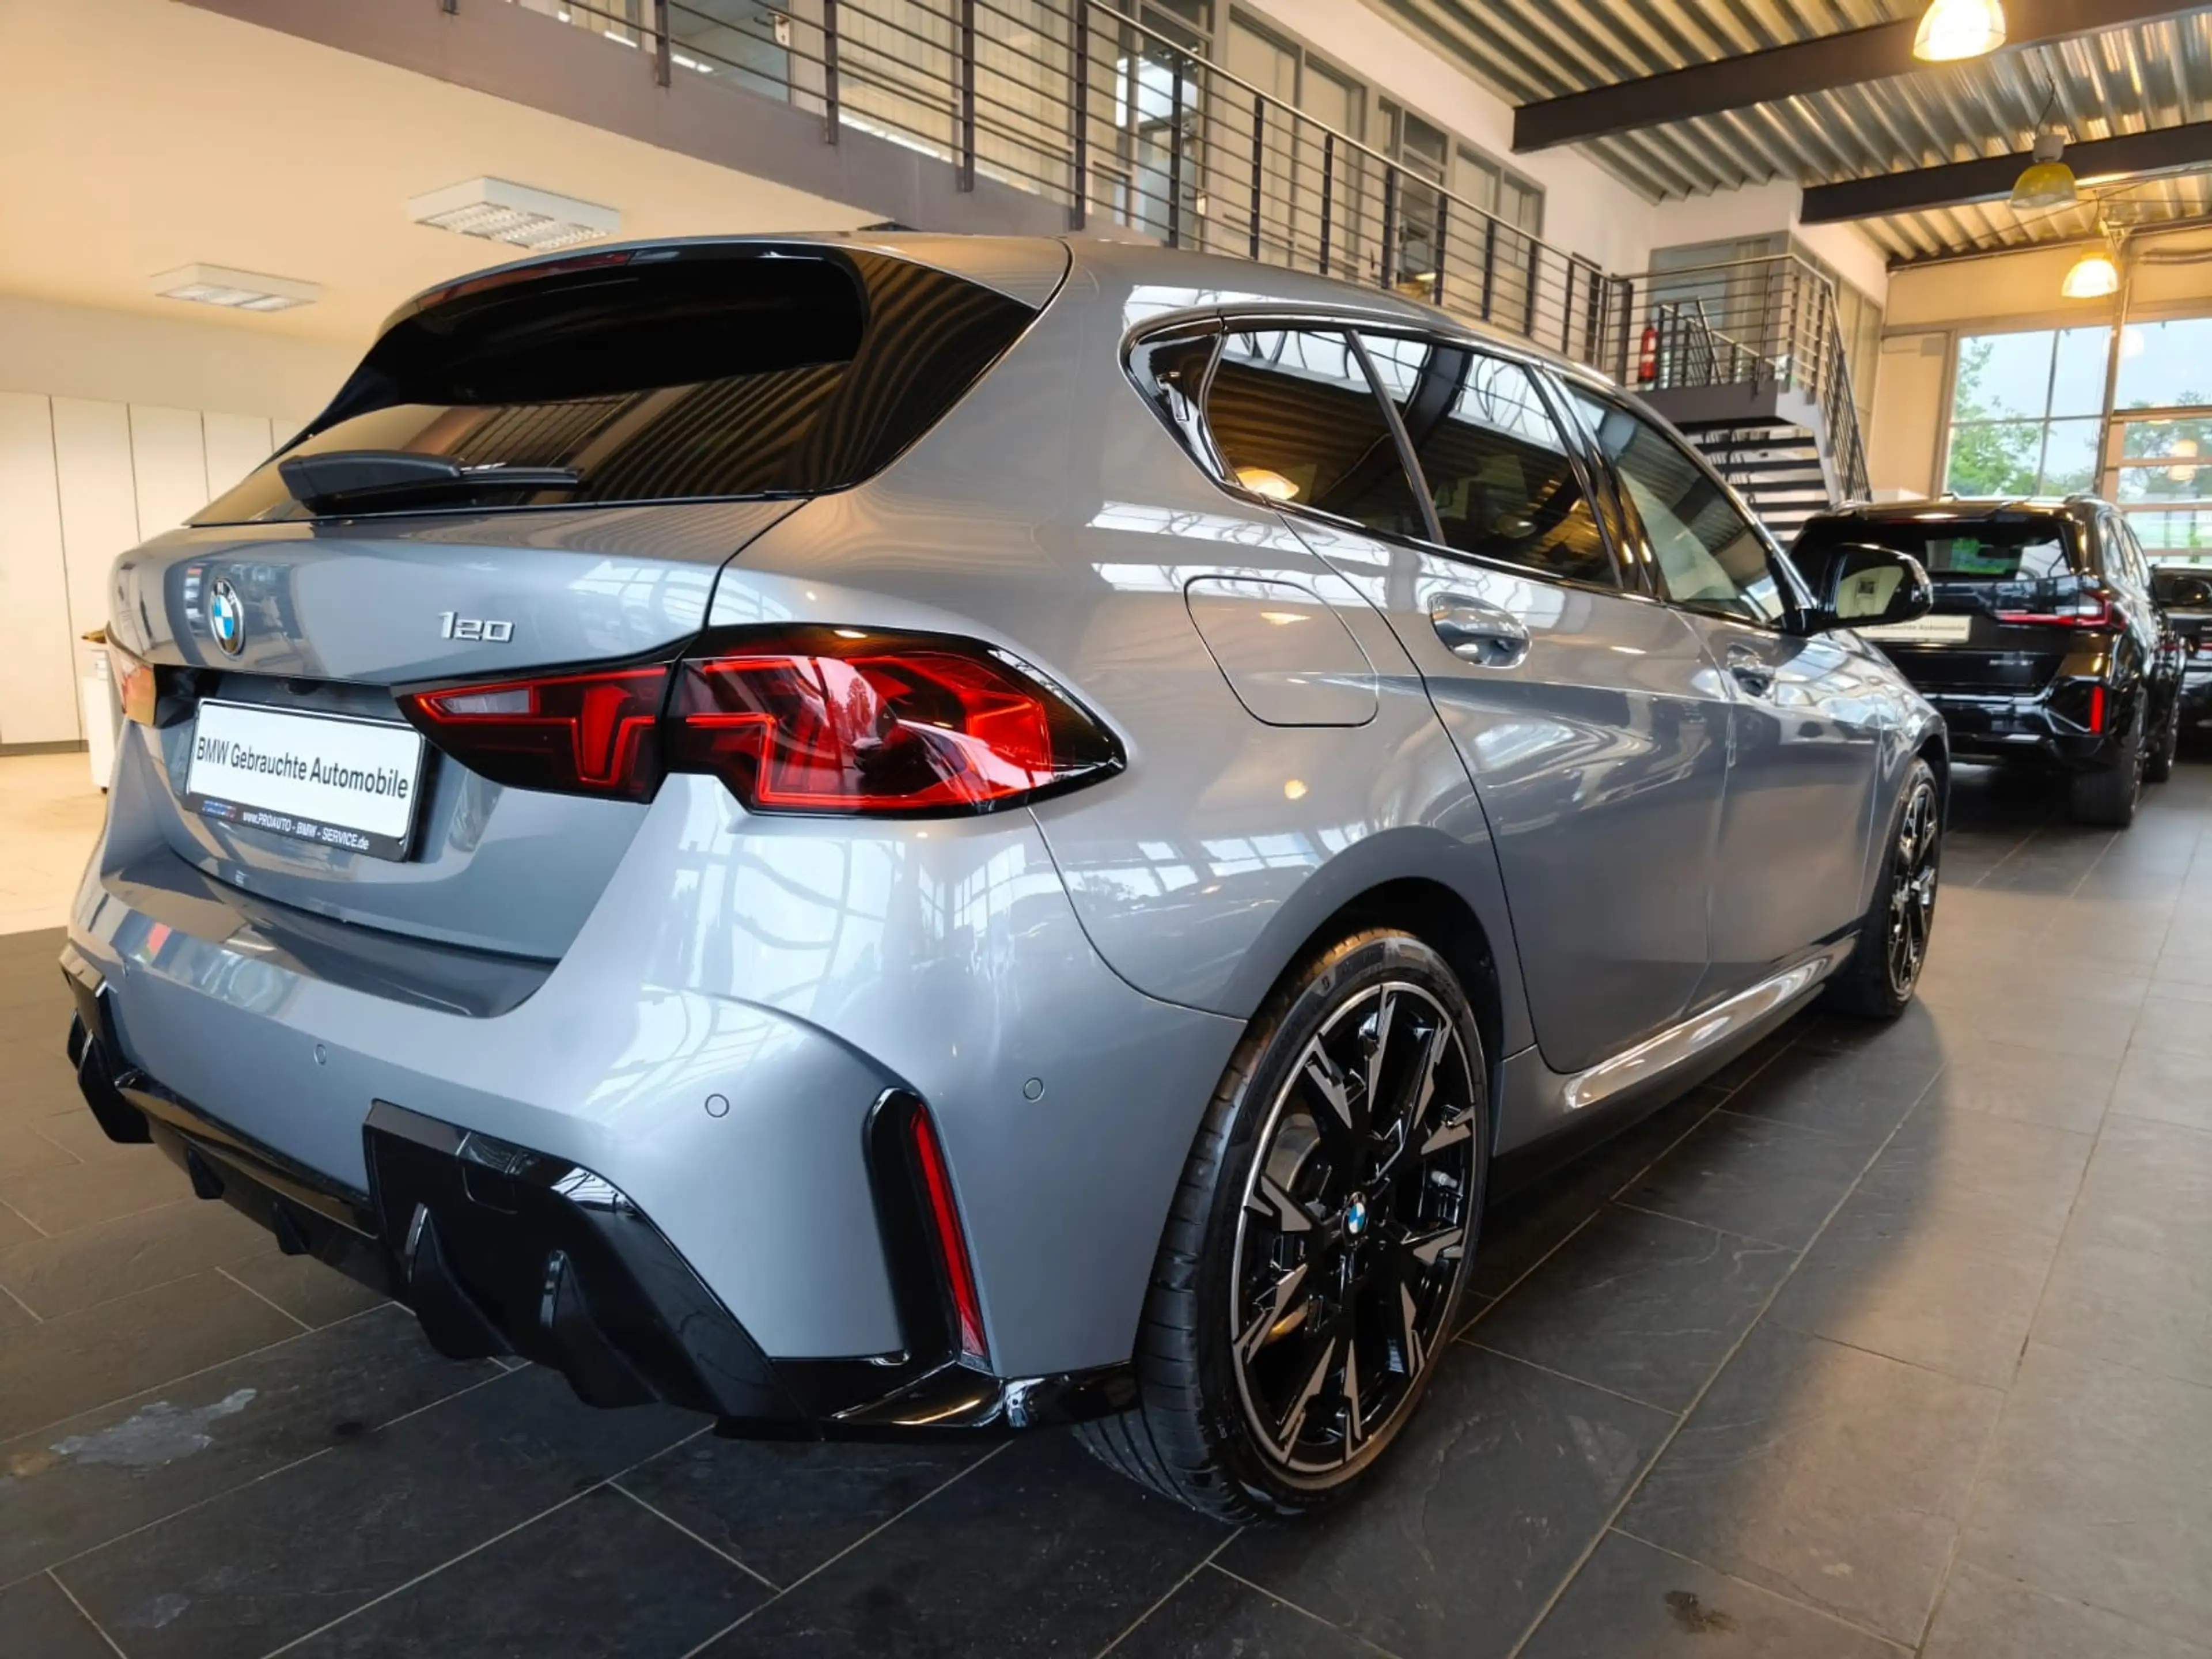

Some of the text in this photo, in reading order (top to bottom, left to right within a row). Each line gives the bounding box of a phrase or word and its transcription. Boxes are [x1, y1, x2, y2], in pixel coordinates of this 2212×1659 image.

[438, 611, 514, 643] 120
[196, 737, 409, 799] BMW Gebrauchte Automobile
[296, 821, 319, 838] BMW
[321, 827, 370, 850] SERVICE.de
